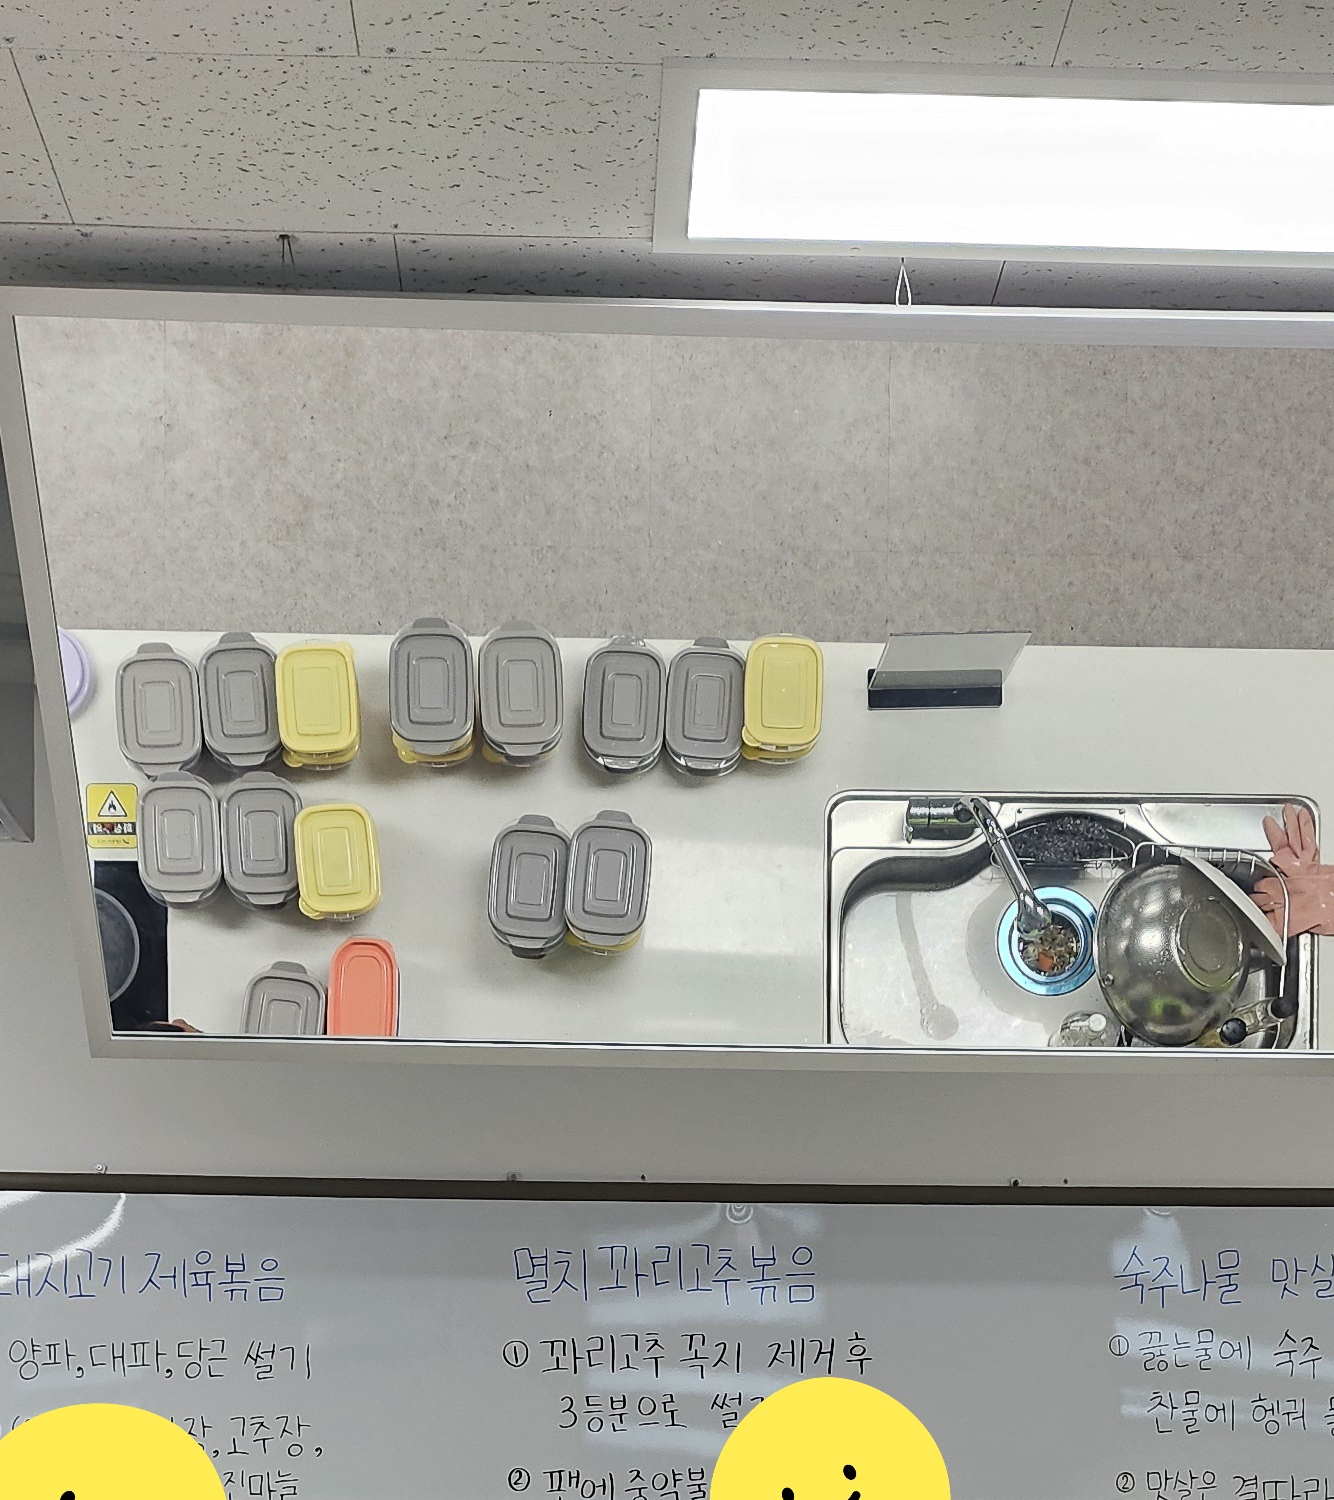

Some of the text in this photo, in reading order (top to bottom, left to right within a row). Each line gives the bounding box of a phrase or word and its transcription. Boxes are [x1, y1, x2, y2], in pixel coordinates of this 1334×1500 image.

[139, 1250, 286, 1302] 제육볶음
[513, 1246, 589, 1305] 멸치
[1114, 1245, 1243, 1308] 숙주나물
[243, 1340, 312, 1381] 썰기
[539, 1332, 667, 1377] 꽈리고추
[680, 1333, 742, 1380] 꼭지
[1272, 1331, 1323, 1378] 숙주
[559, 1393, 765, 1433] 3등분으로 썰
[1146, 1391, 1235, 1435] 찬물에
[1250, 1393, 1307, 1435] 헹궈
